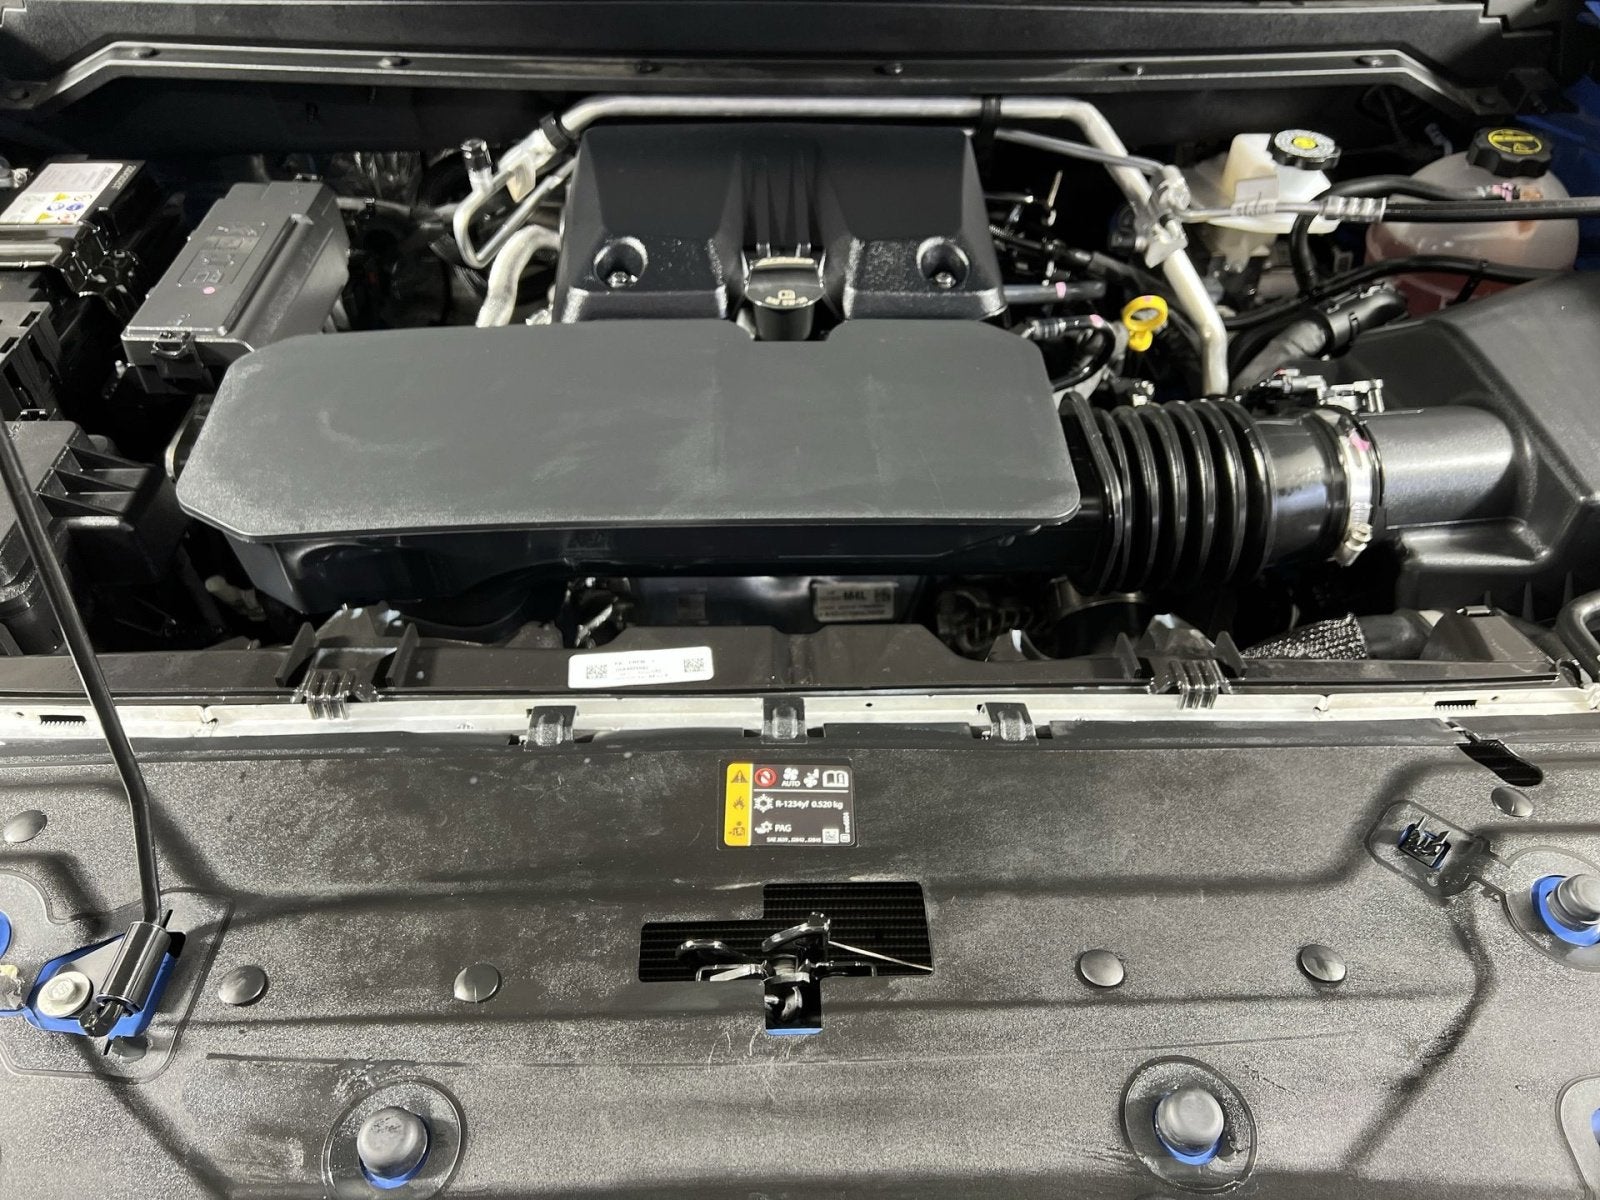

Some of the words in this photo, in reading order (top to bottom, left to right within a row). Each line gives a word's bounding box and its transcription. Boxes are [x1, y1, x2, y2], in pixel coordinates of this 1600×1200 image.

[775, 800, 810, 810] R-1234yf
[811, 800, 832, 808] 0.520
[833, 800, 843, 810] kg
[774, 824, 792, 833] PAG
